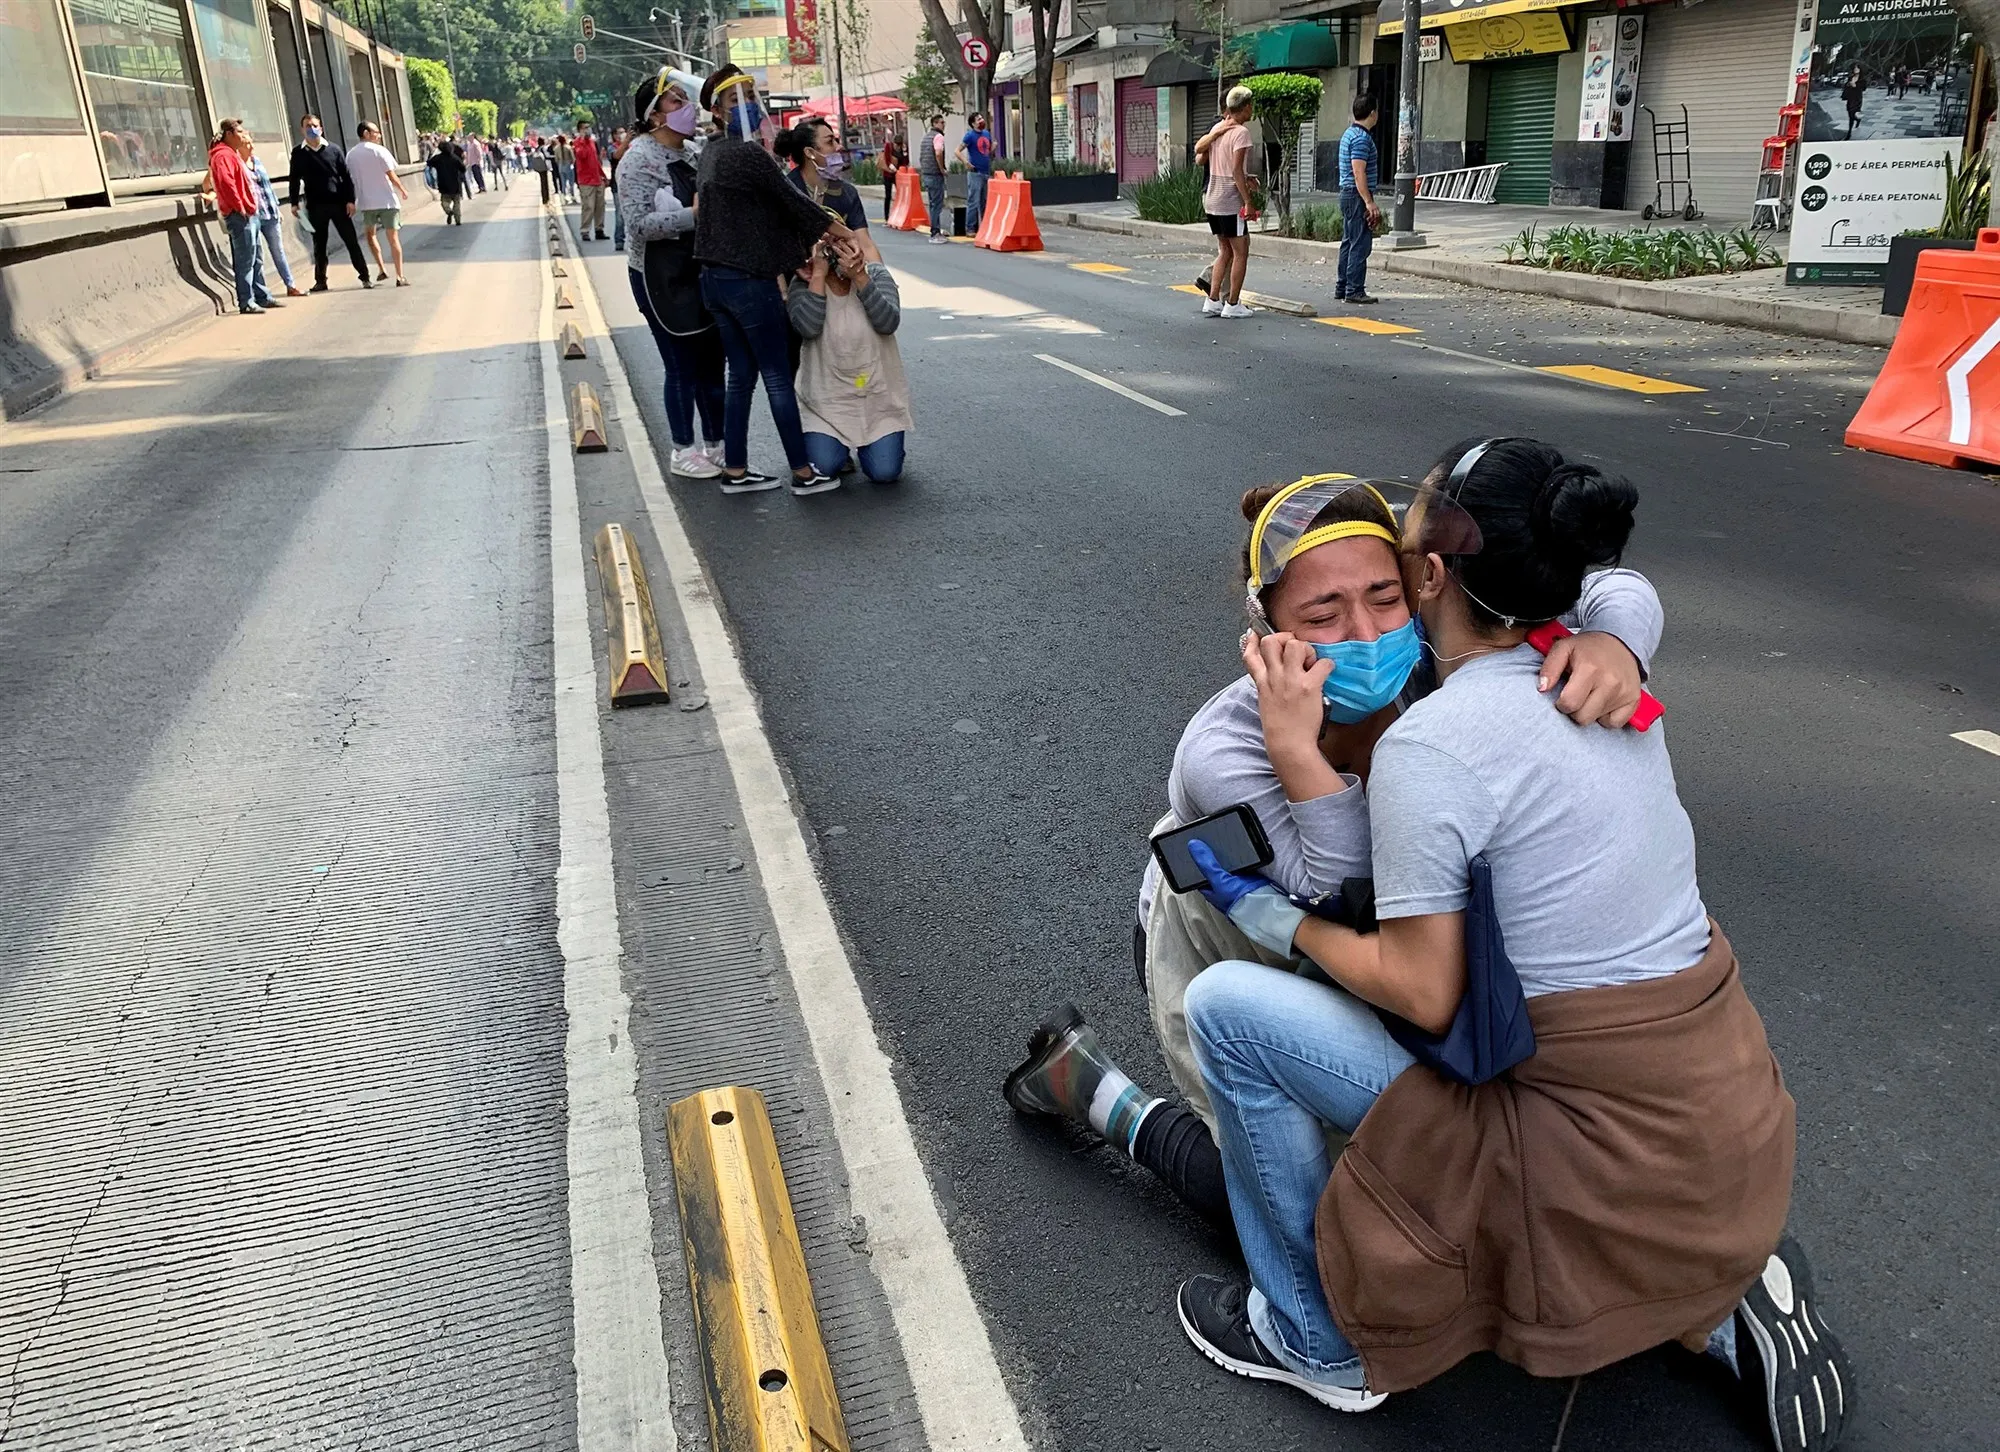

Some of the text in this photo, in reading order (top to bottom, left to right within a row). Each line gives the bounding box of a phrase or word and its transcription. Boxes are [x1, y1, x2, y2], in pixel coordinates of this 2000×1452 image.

[1840, 0, 1948, 14] AV. INSURGENTE
[1819, 18, 1841, 26] CALLE
[1842, 16, 1869, 24] PUEBLA
[1897, 12, 1912, 20] SUR
[1913, 10, 1932, 18] BAJA
[1933, 9, 1958, 17] CALIF
[970, 45, 982, 63] E
[1587, 92, 1601, 100] Local
[1808, 161, 1829, 170] 1,959
[1844, 162, 1858, 170] DE
[1860, 160, 1888, 170] ÁREA
[1840, 194, 1854, 202] DE
[1857, 192, 1884, 202] ÁREA
[1887, 193, 1942, 201] PEATONAL
